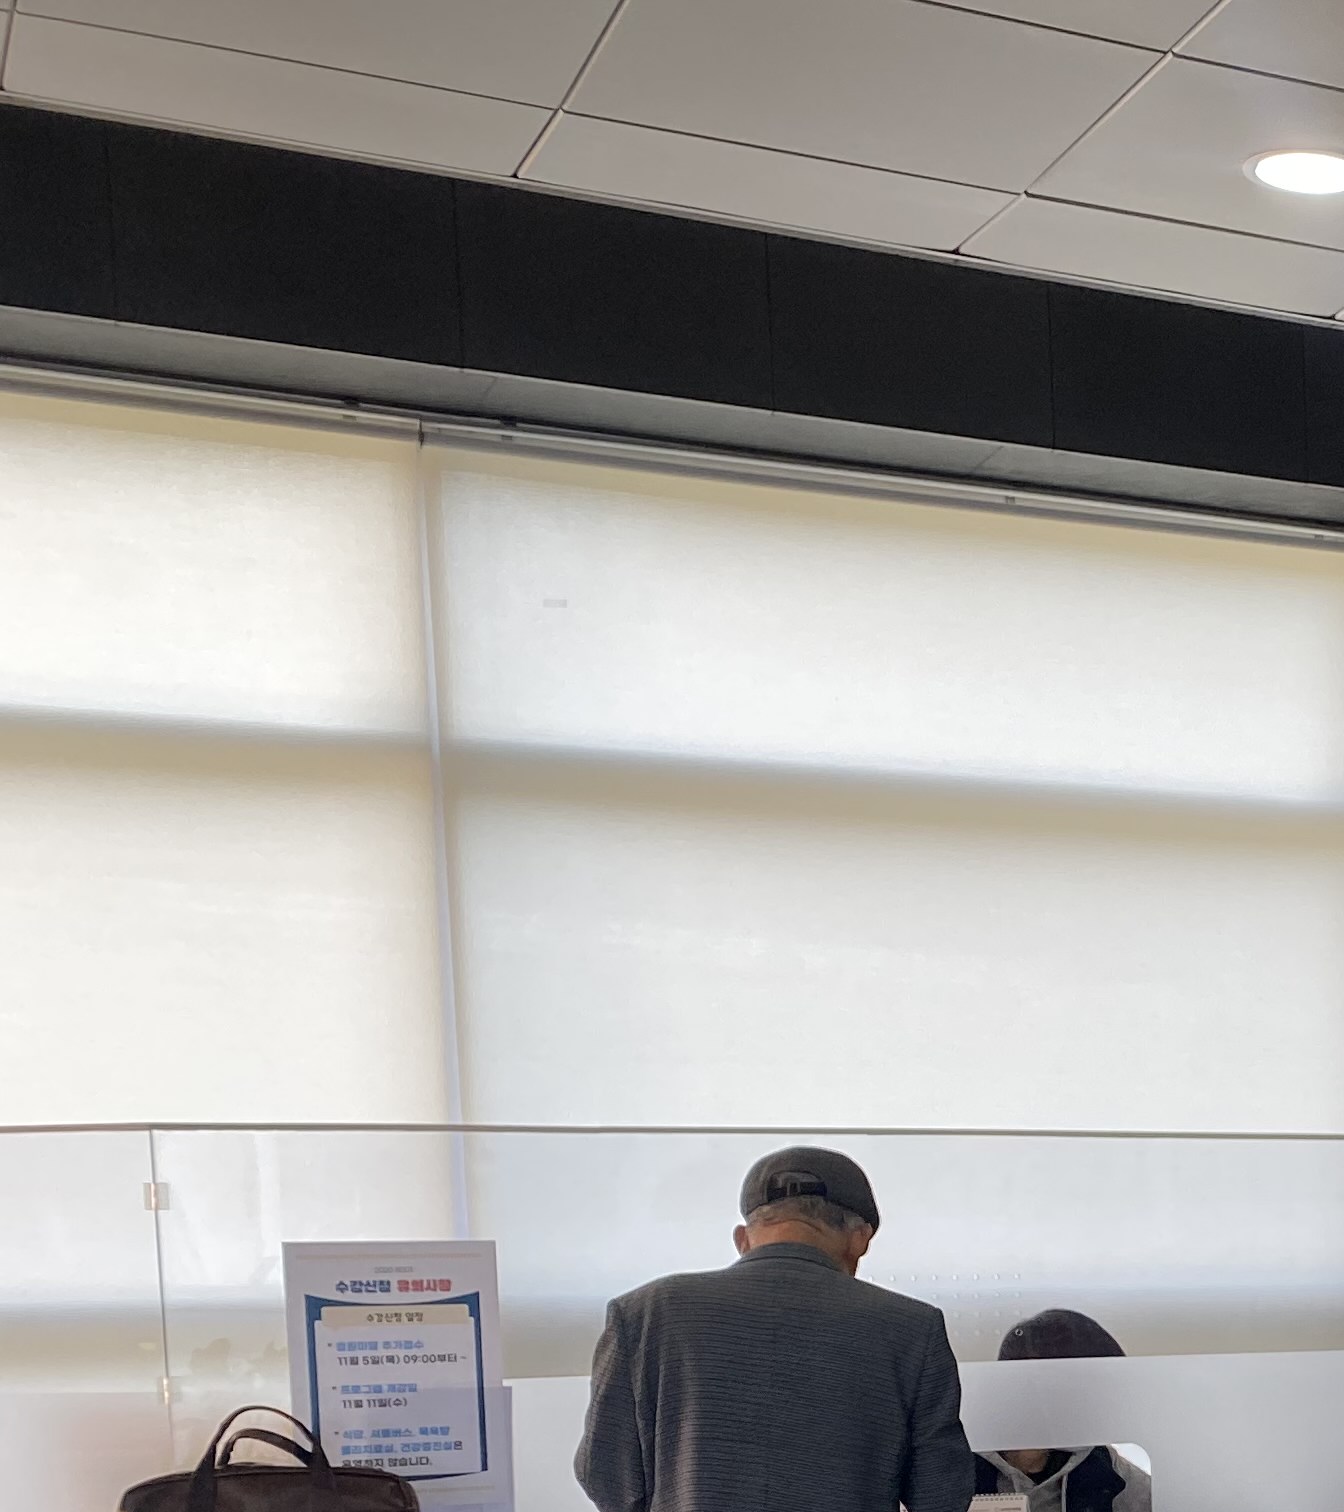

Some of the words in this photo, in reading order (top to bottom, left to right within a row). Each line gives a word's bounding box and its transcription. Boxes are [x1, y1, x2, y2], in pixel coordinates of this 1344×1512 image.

[335, 1279, 392, 1295] 수강신청
[366, 1312, 402, 1323] 수강신청
[405, 1311, 424, 1322] 일정
[337, 1356, 359, 1367] 11월
[342, 1400, 363, 1409] 11월
[367, 1398, 408, 1409] 11일(수)
[388, 1455, 433, 1468] 않습니다.
